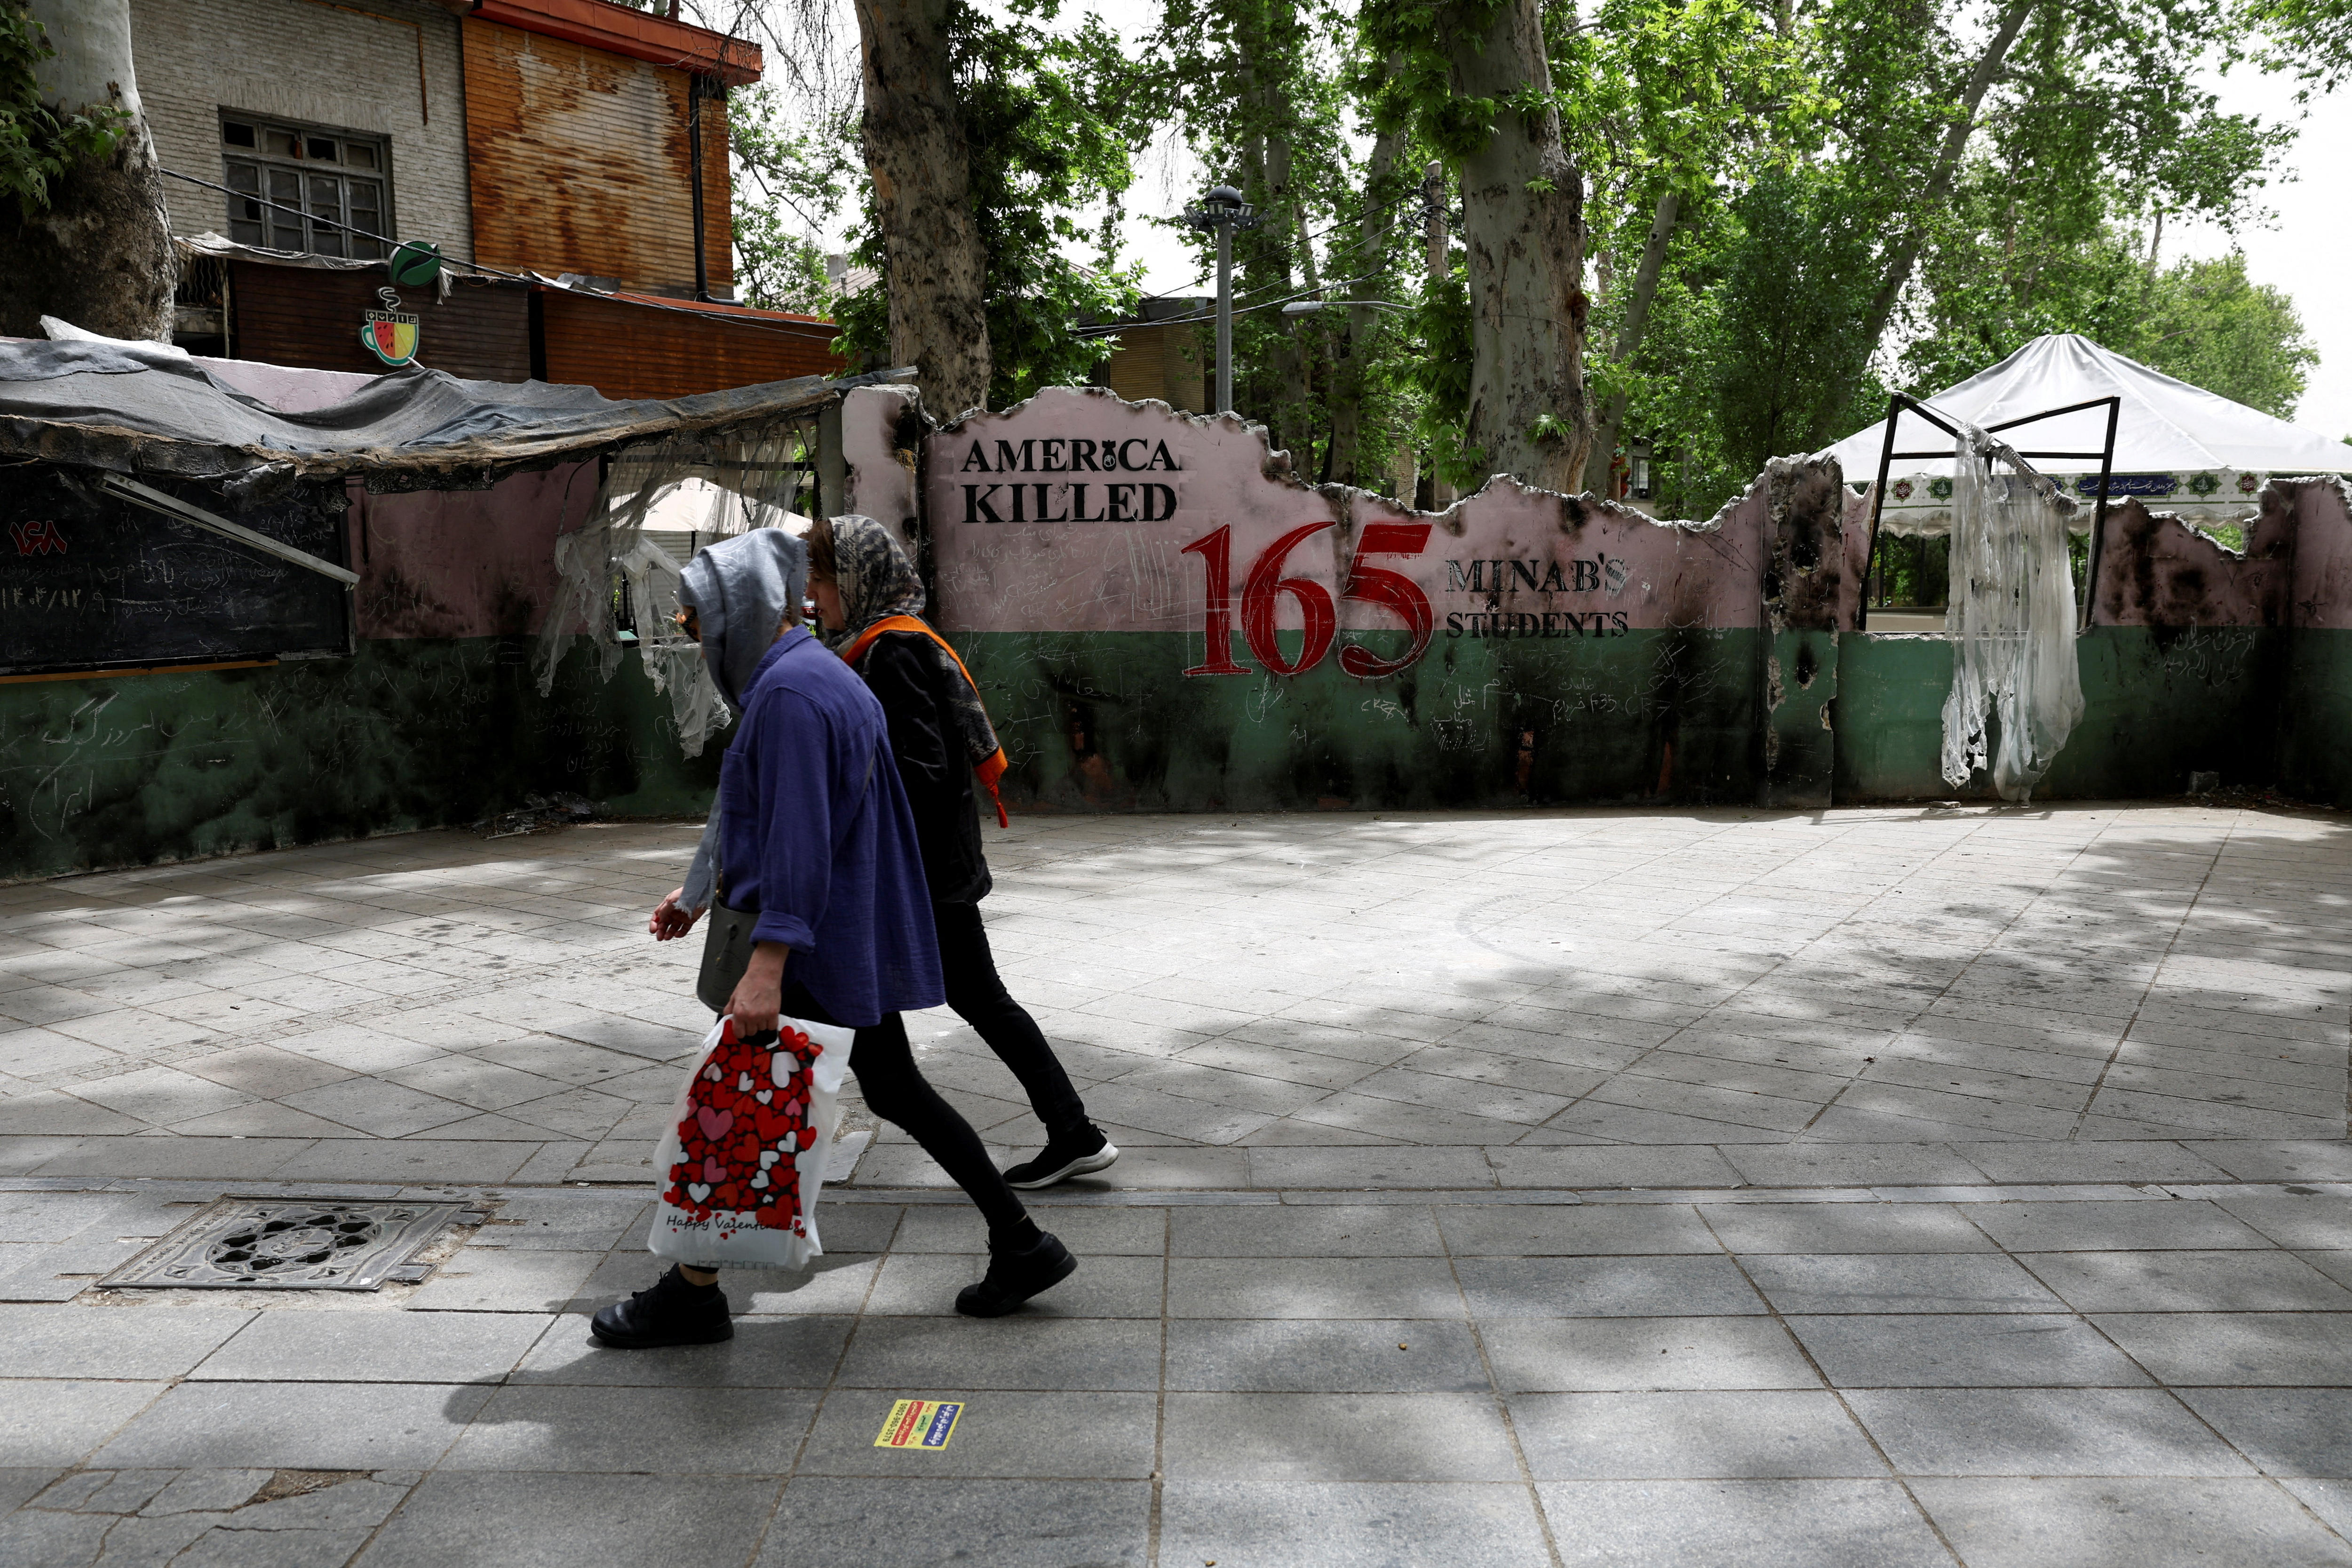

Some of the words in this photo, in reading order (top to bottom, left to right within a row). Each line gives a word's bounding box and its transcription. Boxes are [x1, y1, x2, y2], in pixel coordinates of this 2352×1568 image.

[960, 438, 1181, 472] AMERICA
[960, 483, 1177, 523] KILLED
[1445, 553, 1627, 594] MINAB'S
[1181, 520, 1435, 680] 165
[1446, 610, 1629, 639] STUDENTS
[666, 1215, 710, 1231] Happy
[715, 1218, 783, 1232] Valentine
